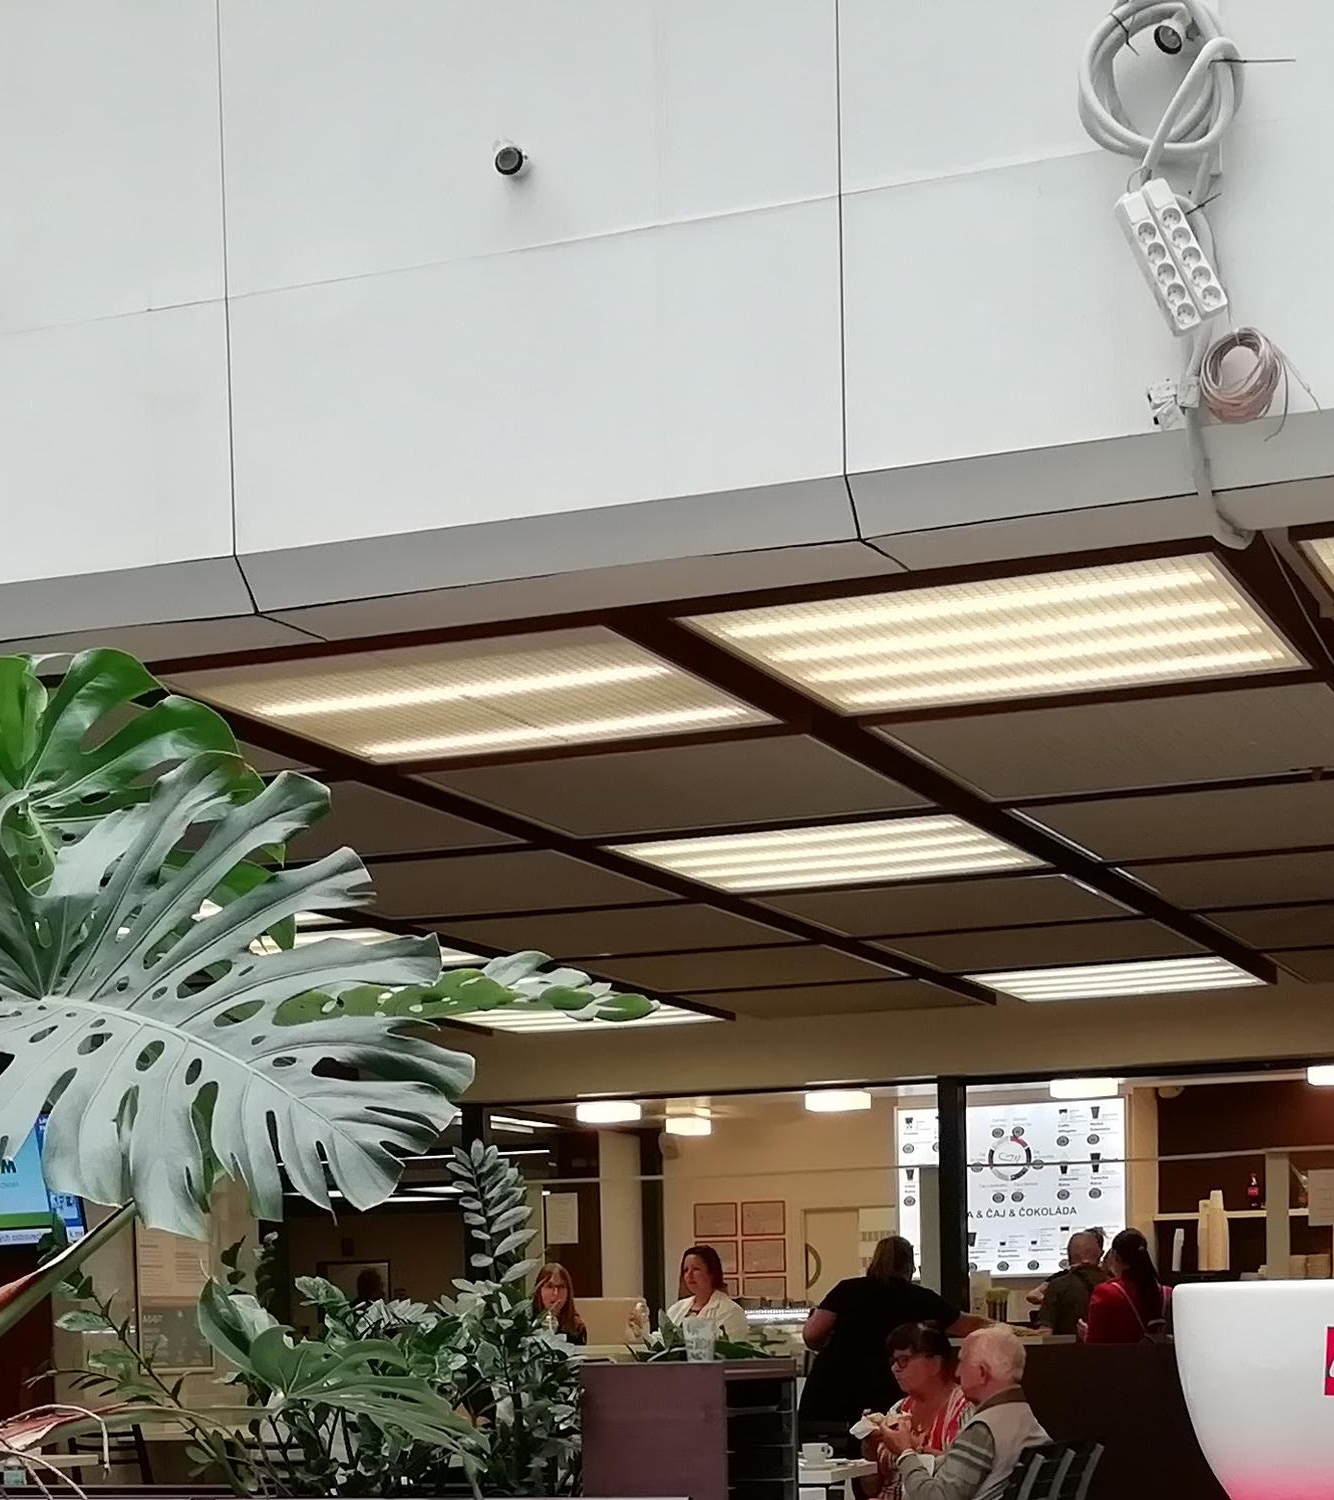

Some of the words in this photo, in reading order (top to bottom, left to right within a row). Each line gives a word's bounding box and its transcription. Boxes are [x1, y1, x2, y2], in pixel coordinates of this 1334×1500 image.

[976, 1210, 984, 1219] &
[986, 1207, 1006, 1218] ČAJ
[1008, 1208, 1016, 1218] &
[1018, 1205, 1078, 1217] ČOKOLÁDA
